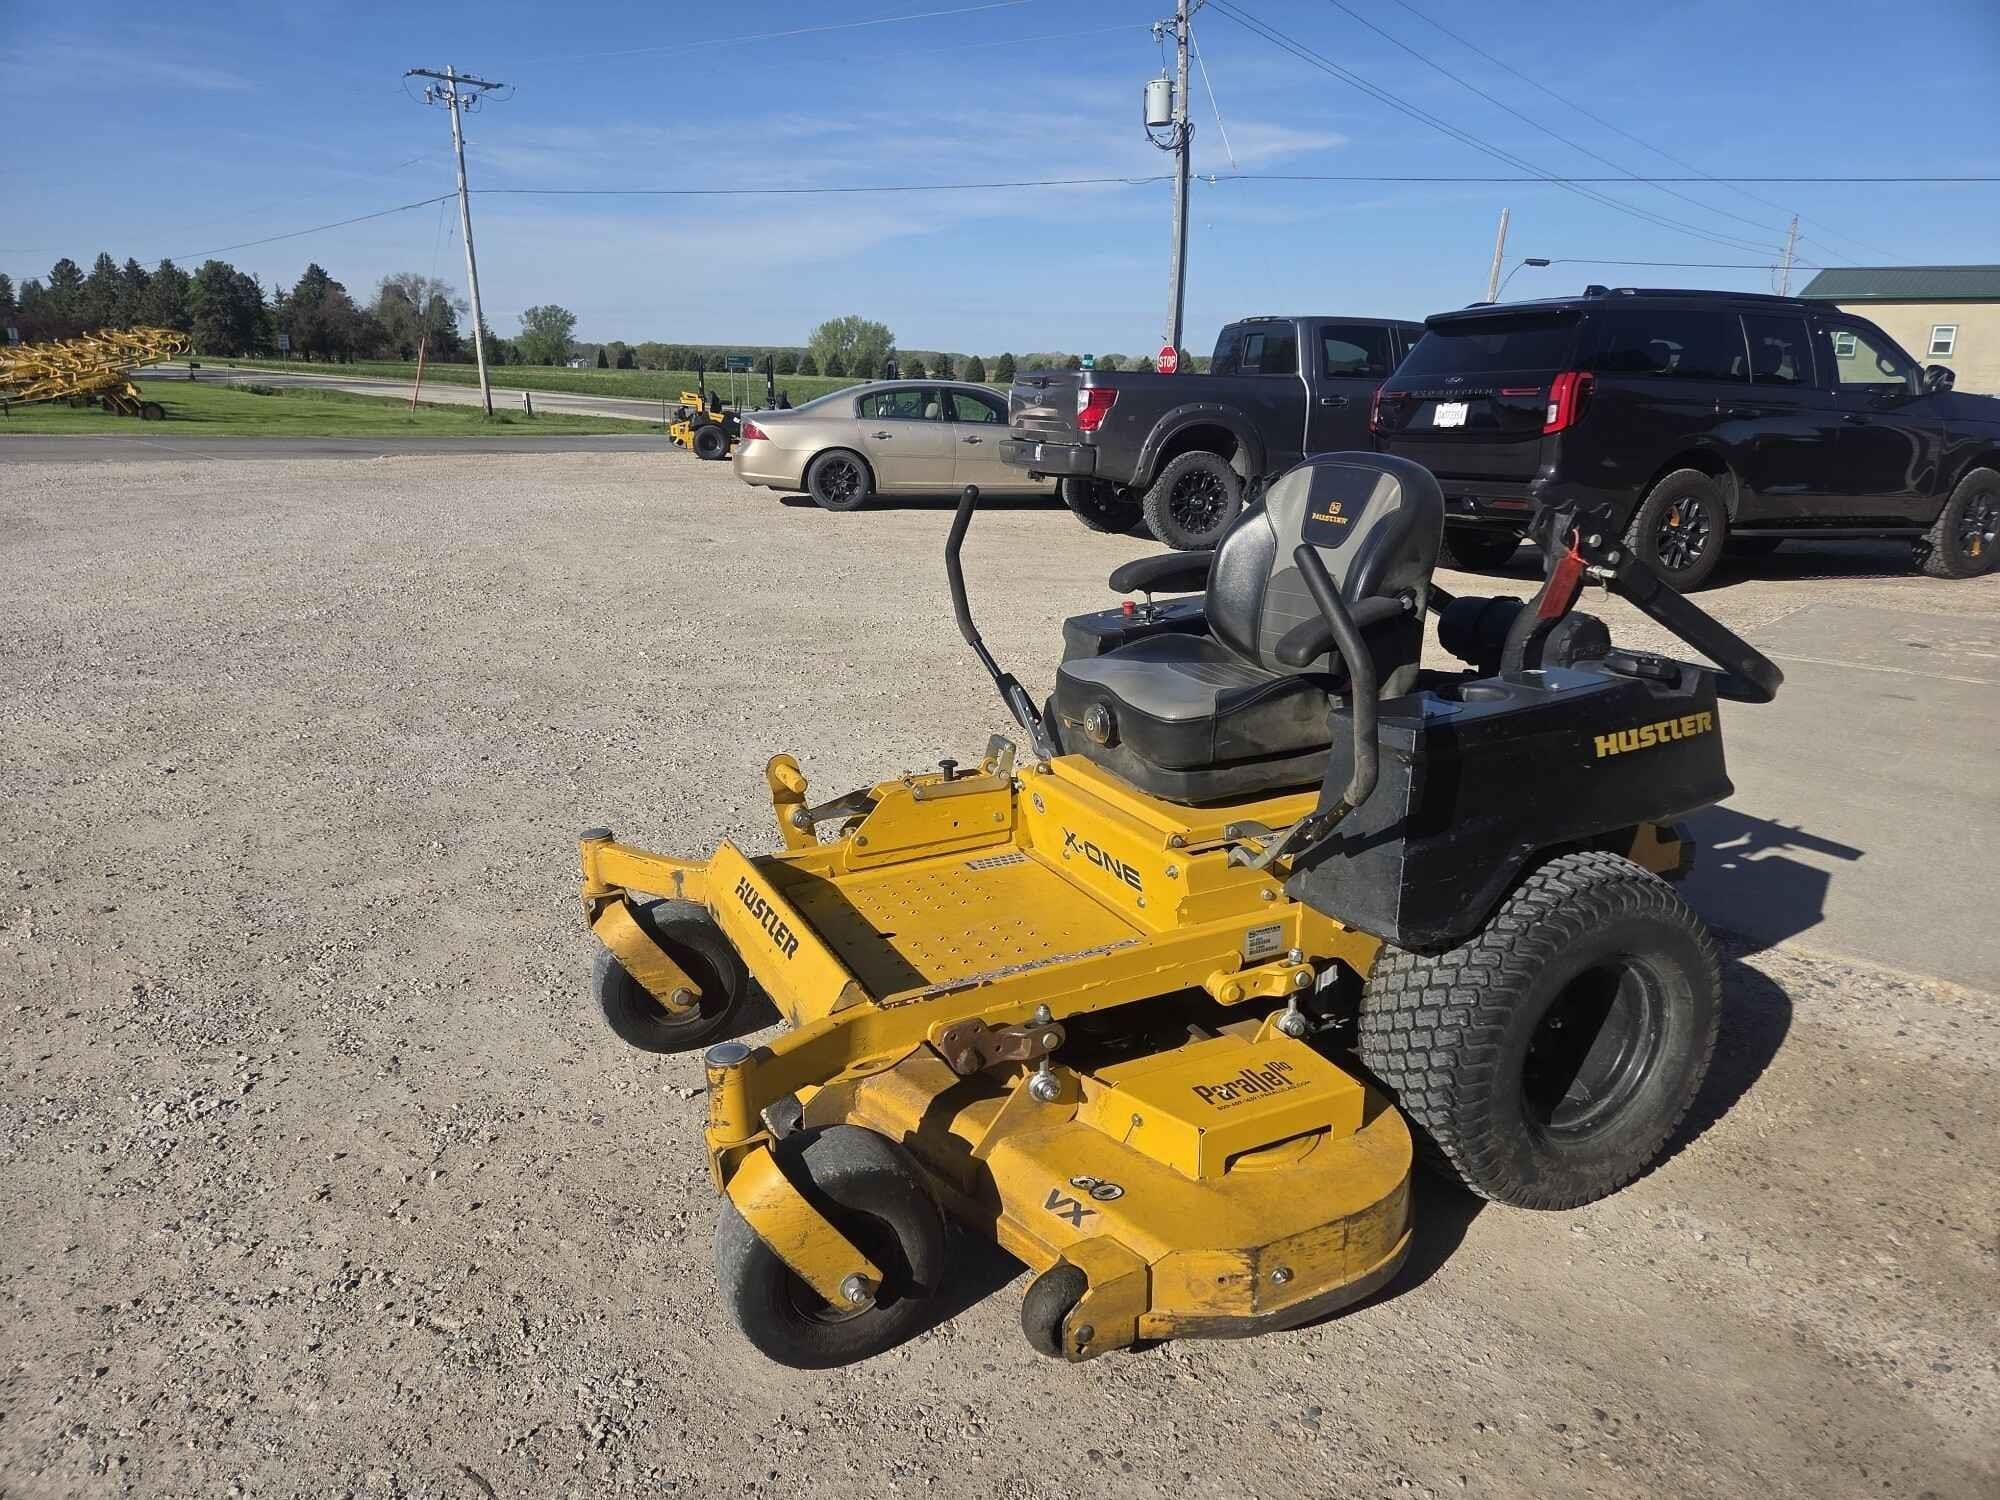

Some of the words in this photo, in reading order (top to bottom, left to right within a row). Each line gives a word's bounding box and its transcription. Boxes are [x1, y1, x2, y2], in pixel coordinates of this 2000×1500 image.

[1159, 355, 1176, 368] STOP
[1594, 711, 1713, 758] HUSTLER
[1062, 826, 1143, 892] X-ONE
[735, 876, 799, 961] HUSTLER
[1044, 1188, 1097, 1229] VX
